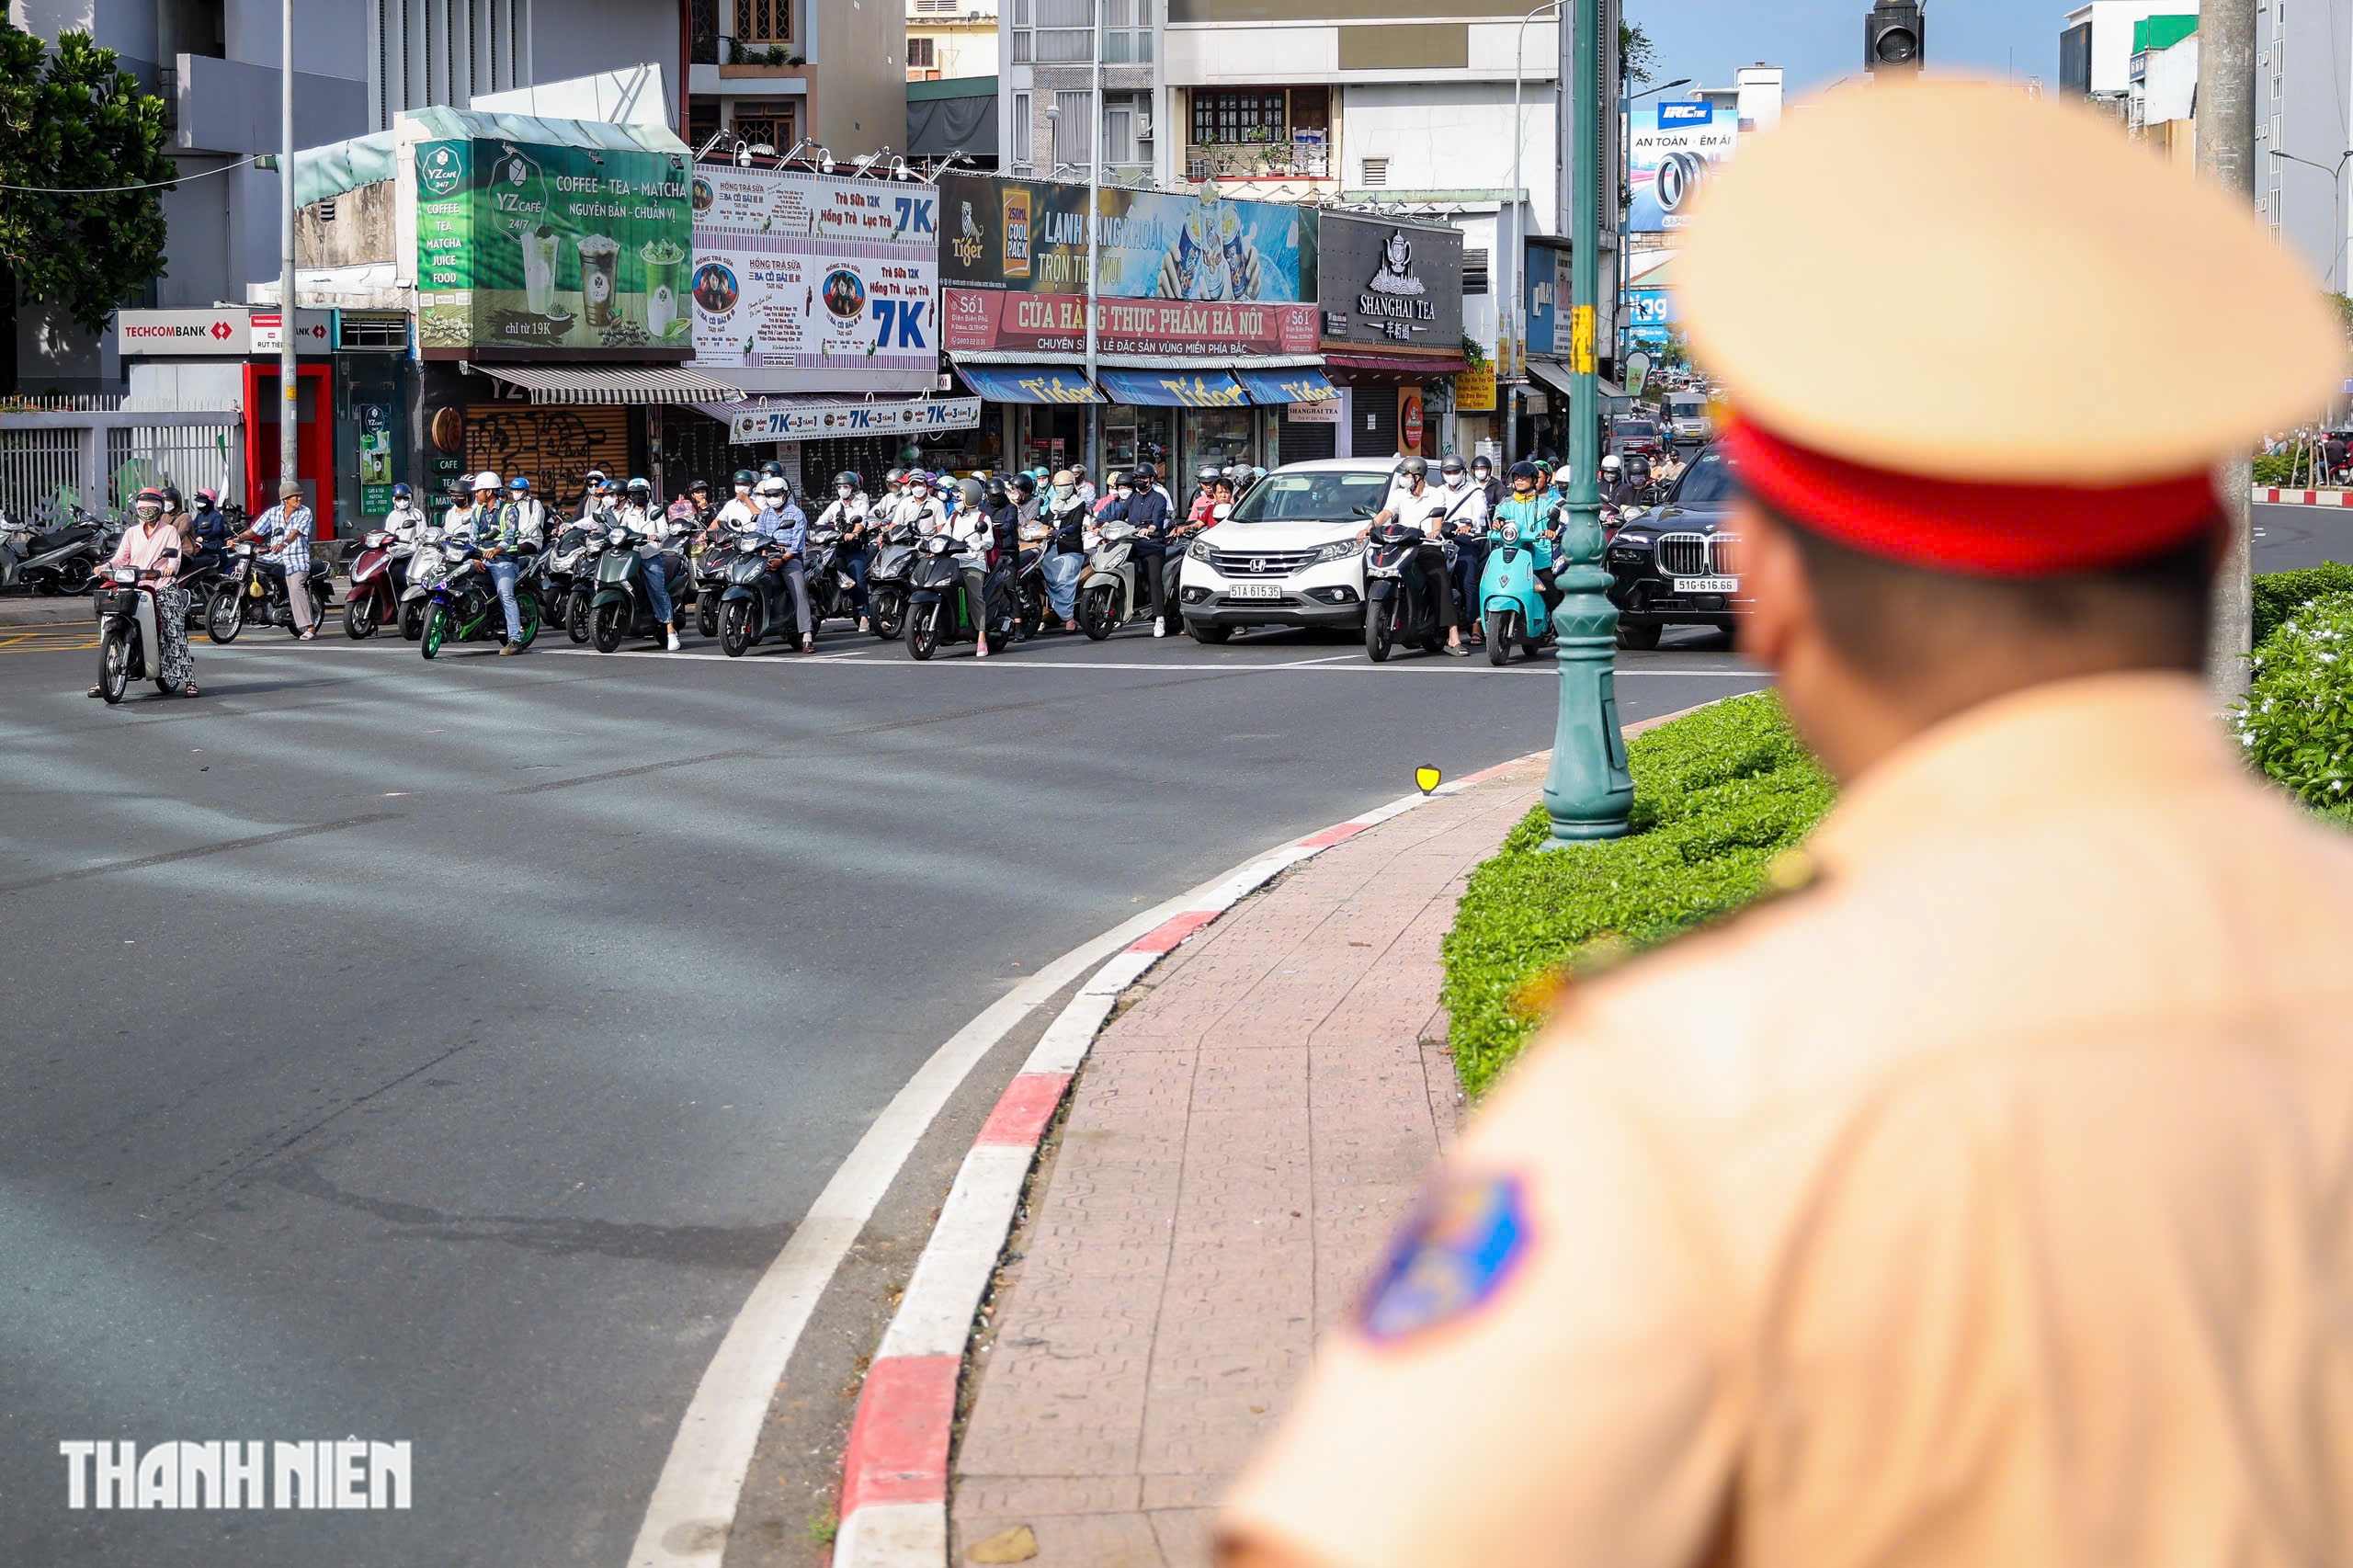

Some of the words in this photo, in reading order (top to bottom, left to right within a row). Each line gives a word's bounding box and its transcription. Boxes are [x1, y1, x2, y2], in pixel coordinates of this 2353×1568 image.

[1663, 106, 1696, 119] IRC
[1636, 138, 1653, 147] AN
[1655, 135, 1688, 146] TOÀN
[1699, 135, 1717, 146] ÊM
[1719, 135, 1732, 145] ÁI
[427, 169, 442, 179] YZ
[442, 170, 457, 179] CAFÉ
[436, 180, 449, 188] 24/7
[556, 176, 598, 194] COFFEE
[608, 181, 631, 196] TEA
[641, 182, 688, 199] MATCHA
[720, 180, 738, 191] HỒNG
[739, 183, 752, 192] TRÀ
[752, 183, 765, 194] SỮA
[496, 193, 518, 212] YZ
[518, 200, 541, 213] CAFÉ
[835, 191, 847, 206] Trà
[849, 192, 865, 208] Sữa
[867, 195, 881, 208] 12K
[426, 203, 459, 214] COFFEE
[569, 202, 607, 217] NGUYÊN
[608, 204, 627, 218] BẢN
[634, 199, 665, 221] CHUẨN
[666, 207, 676, 223] VỊ
[895, 197, 934, 233] 7K
[1008, 207, 1028, 221] 250ML
[821, 208, 843, 226] Hồng
[844, 210, 858, 225] Trà
[863, 213, 878, 230] Lục
[879, 214, 892, 228] Trà
[436, 221, 453, 232] TEA
[508, 219, 529, 230] 24/7
[1044, 211, 1083, 247] LẠNH
[1123, 218, 1163, 250] KHOÁI
[1007, 223, 1029, 241] COOL
[426, 238, 462, 249] MATCHA
[1006, 241, 1029, 260] PACK
[952, 237, 983, 267] Tiger
[433, 256, 456, 267] JUICE
[696, 256, 710, 266] HỒNG
[749, 256, 770, 269] HỒNG
[772, 258, 787, 270] TRÀ
[787, 259, 801, 271] SỮA
[432, 272, 457, 283] FOOD
[881, 267, 893, 278] Trà
[894, 267, 906, 278] Sữa
[908, 268, 919, 279] 12K
[1038, 254, 1070, 290] TRỌN
[1102, 256, 1123, 285] VUI
[870, 281, 888, 296] Hồng
[889, 283, 901, 295] Trà
[905, 284, 916, 298] Lục
[918, 285, 929, 296] Trà
[961, 294, 976, 313] Số
[978, 297, 983, 313] 1
[1360, 294, 1413, 319] SHANGHAI
[1416, 300, 1436, 321] TEA
[951, 313, 964, 323] Điện
[965, 314, 977, 323] Biên
[977, 314, 988, 323] Phủ
[1018, 295, 1055, 328] CỬA
[1111, 306, 1156, 336] THỰC
[1160, 302, 1208, 335] PHẨM
[1212, 306, 1234, 335] HÀ
[1239, 308, 1265, 339] NỘI
[1291, 309, 1304, 324] Số
[1305, 312, 1309, 324] 1
[125, 325, 206, 337] TECHCOMBANK
[505, 322, 518, 335] chỉ
[519, 322, 530, 335] từ
[531, 322, 551, 335] 19K
[872, 300, 926, 348] 7K
[257, 340, 270, 348] RÚT
[1037, 337, 1074, 350] CHUYÊN
[1076, 335, 1086, 350] SỈ
[1103, 336, 1115, 351] LẺ
[1117, 339, 1135, 354] ĐẶC
[1138, 338, 1157, 353] SẢN
[1158, 340, 1183, 354] VÙNG
[1186, 338, 1206, 354] MIỀN
[1209, 341, 1228, 354] PHÍA
[1230, 341, 1247, 354] BẮC
[849, 410, 870, 428] 7K
[876, 413, 882, 423] 3
[892, 412, 896, 423] 1
[927, 405, 947, 424] 7K
[952, 408, 958, 418] 3
[968, 407, 972, 417] 1
[769, 414, 790, 433] 7K
[797, 416, 802, 427] 3
[813, 416, 817, 426] 1
[440, 460, 458, 470] CAFE
[442, 479, 456, 487] TEA
